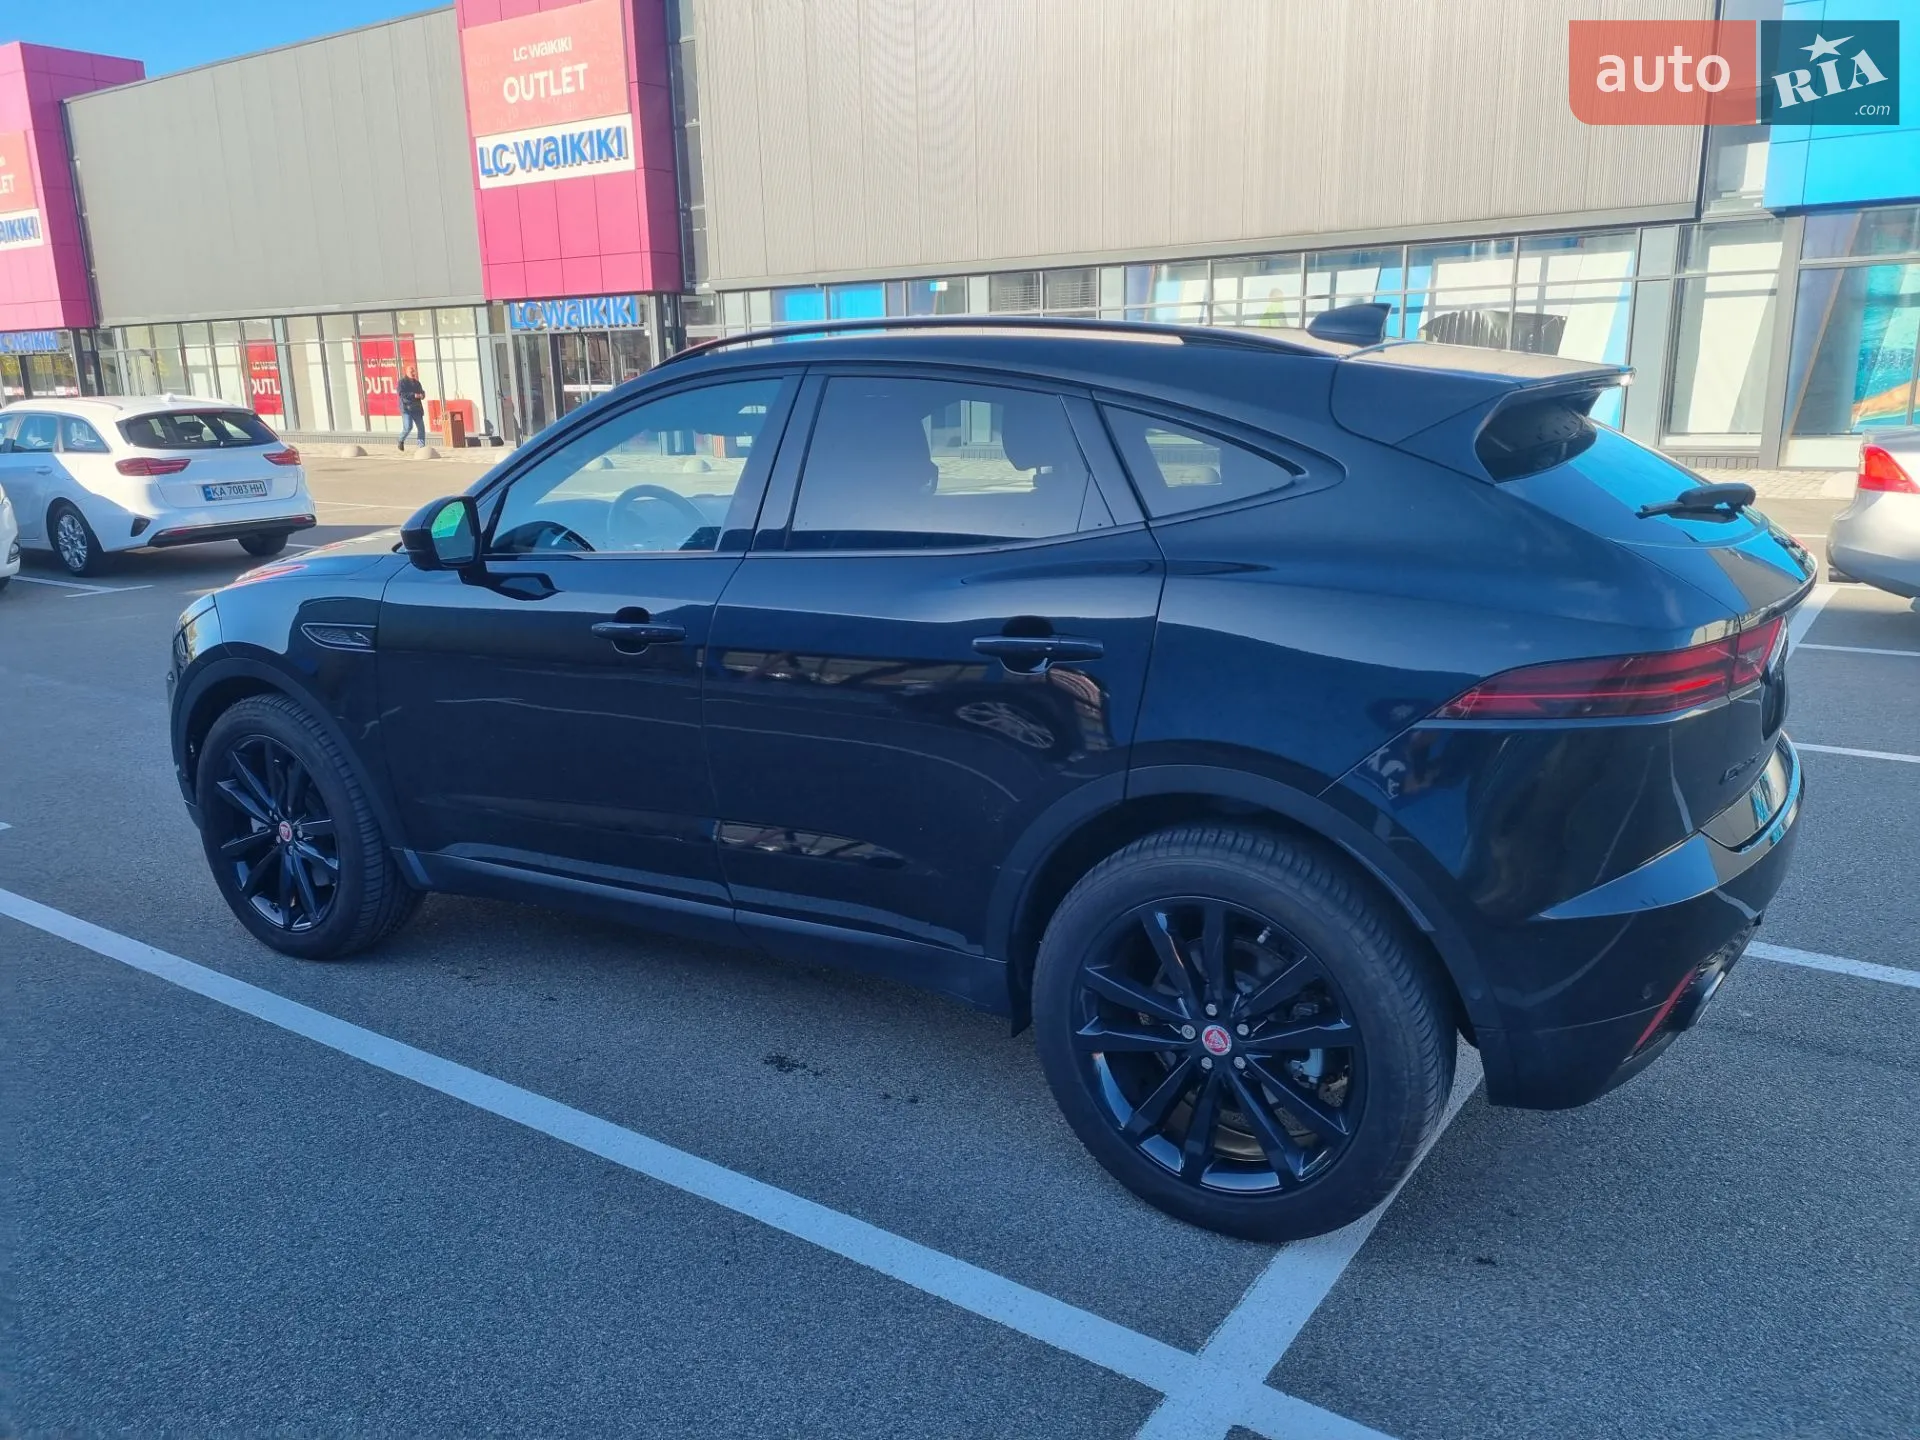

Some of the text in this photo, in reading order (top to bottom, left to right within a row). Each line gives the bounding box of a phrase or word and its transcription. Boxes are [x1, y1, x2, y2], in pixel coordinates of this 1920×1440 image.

[513, 44, 528, 62] LC
[503, 63, 588, 104] OUTLET
[478, 142, 513, 177] LC
[510, 300, 542, 330] LC
[211, 486, 226, 497] KA
[227, 484, 249, 495] 7083
